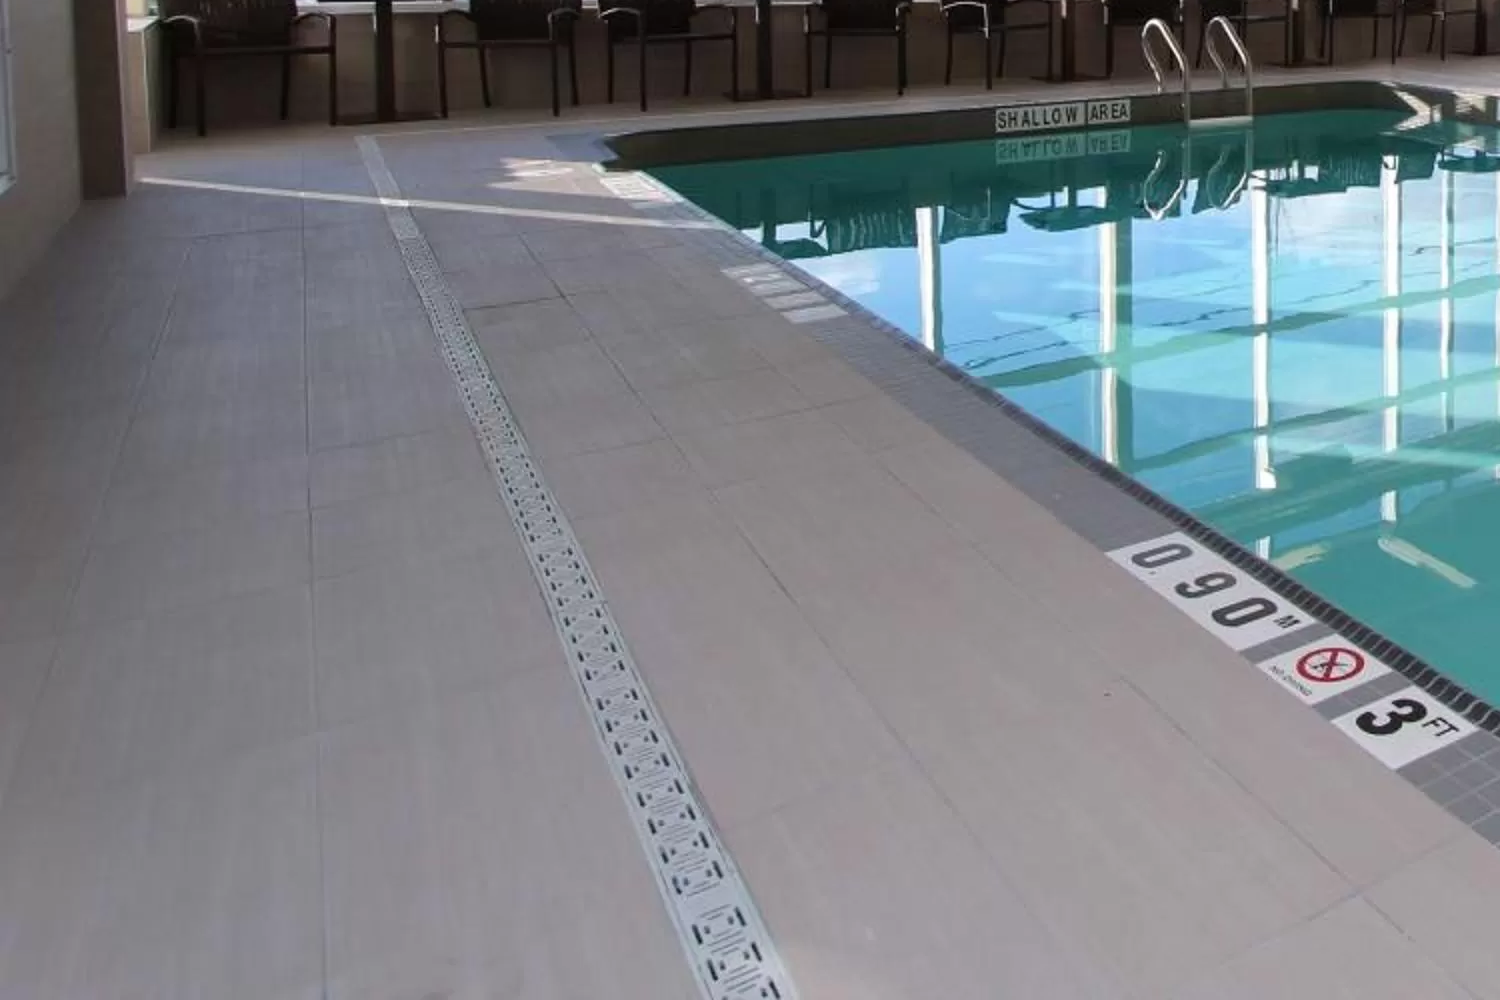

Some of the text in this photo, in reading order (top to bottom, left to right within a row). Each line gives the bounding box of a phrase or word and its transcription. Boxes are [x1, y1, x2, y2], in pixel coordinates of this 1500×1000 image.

[997, 103, 1129, 129] SHALLOW AREA
[1355, 699, 1460, 737] 3 FT
